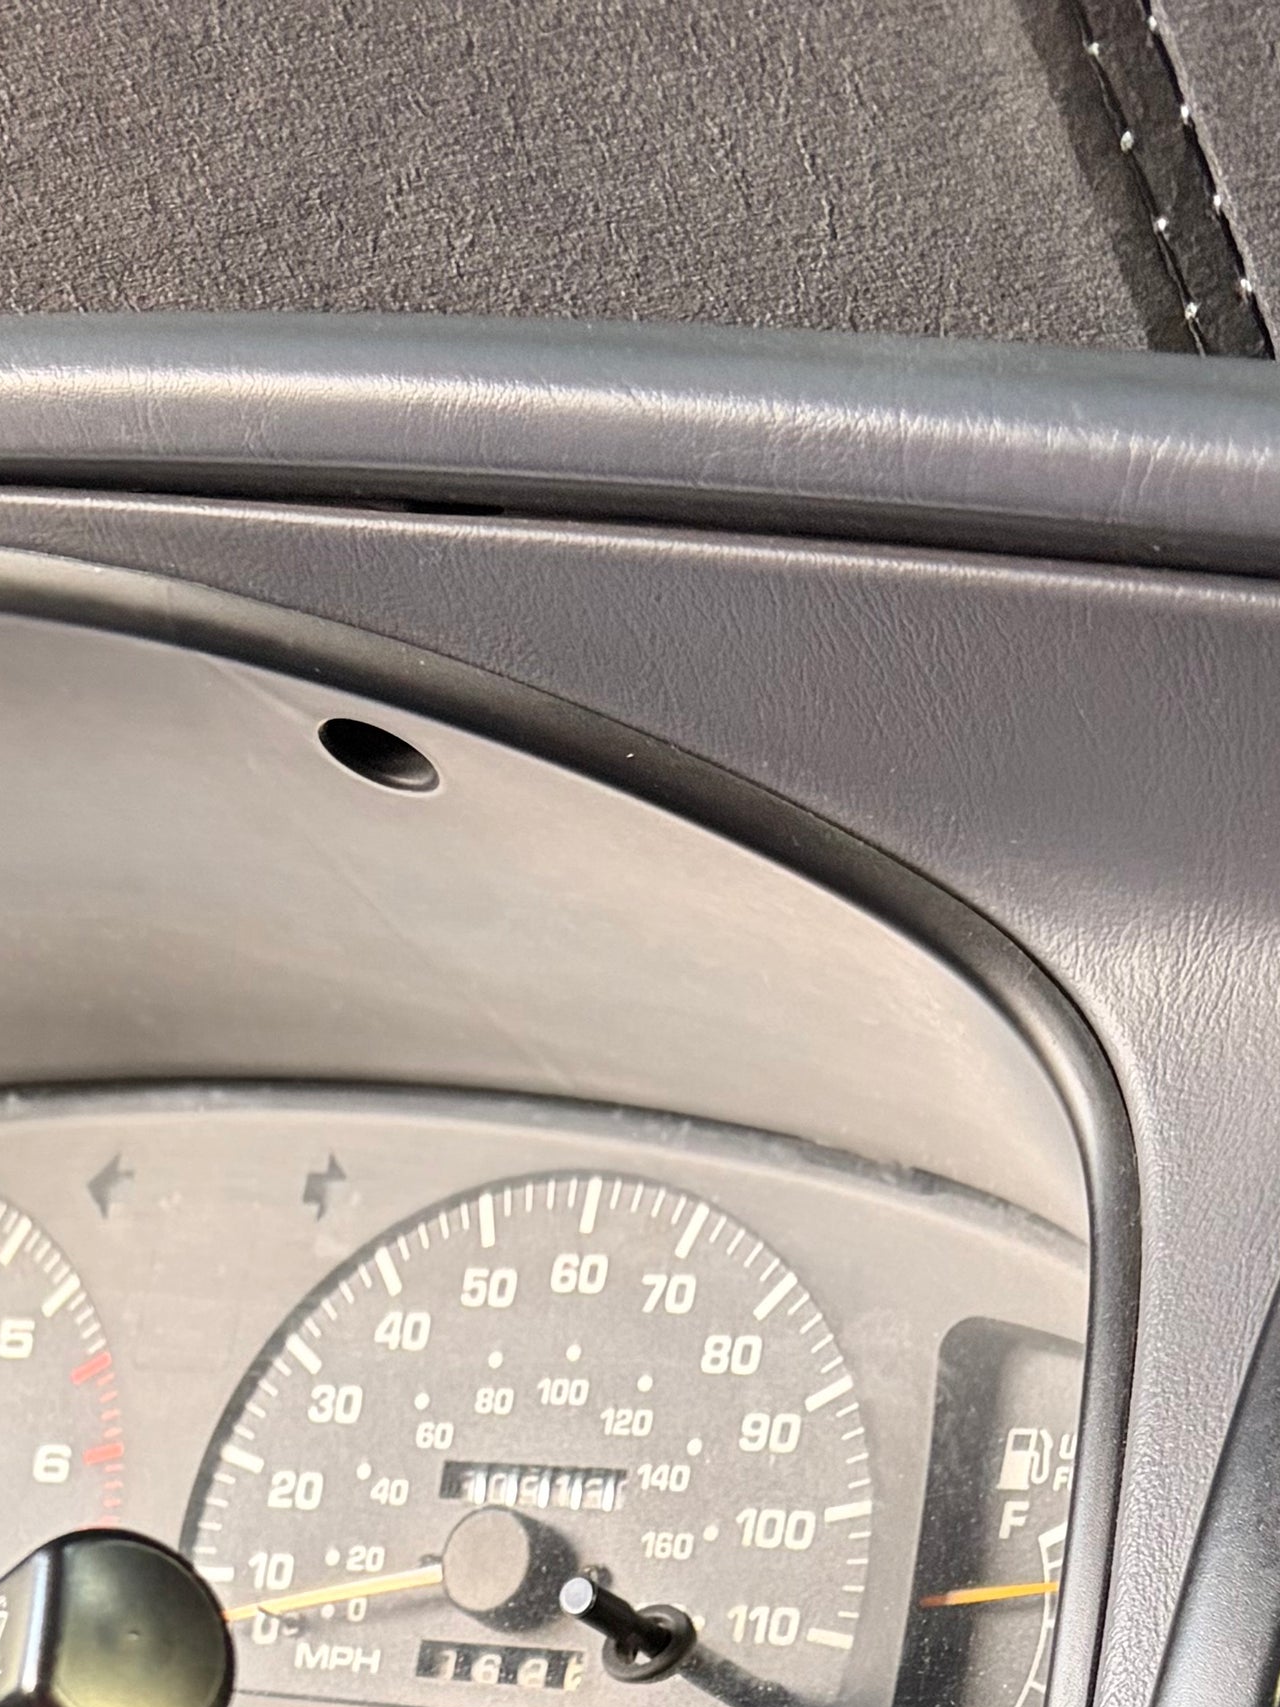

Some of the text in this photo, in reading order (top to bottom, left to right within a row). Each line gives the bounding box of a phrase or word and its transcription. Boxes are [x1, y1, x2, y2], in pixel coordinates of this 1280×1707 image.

[460, 1267, 518, 1308] 50
[549, 1253, 608, 1295] 60
[641, 1273, 697, 1315] 70
[374, 1311, 431, 1352] 40
[700, 1334, 763, 1376] 80
[307, 1384, 363, 1424] 30
[474, 1387, 514, 1415] 80
[536, 1378, 589, 1407] 100
[415, 1421, 455, 1449] 60
[600, 1407, 654, 1438] 120
[738, 1412, 802, 1454] 90
[32, 1443, 71, 1484] 6
[636, 1464, 690, 1493] 140
[267, 1472, 324, 1511] 20
[371, 1478, 409, 1506] 40
[735, 1508, 817, 1550] 100
[998, 1500, 1030, 1540] F
[346, 1545, 385, 1572] 20
[640, 1532, 694, 1561] 160
[248, 1551, 294, 1590] 10
[347, 1597, 368, 1622] 0
[727, 1605, 801, 1646] 110
[294, 1642, 381, 1674] MPH
